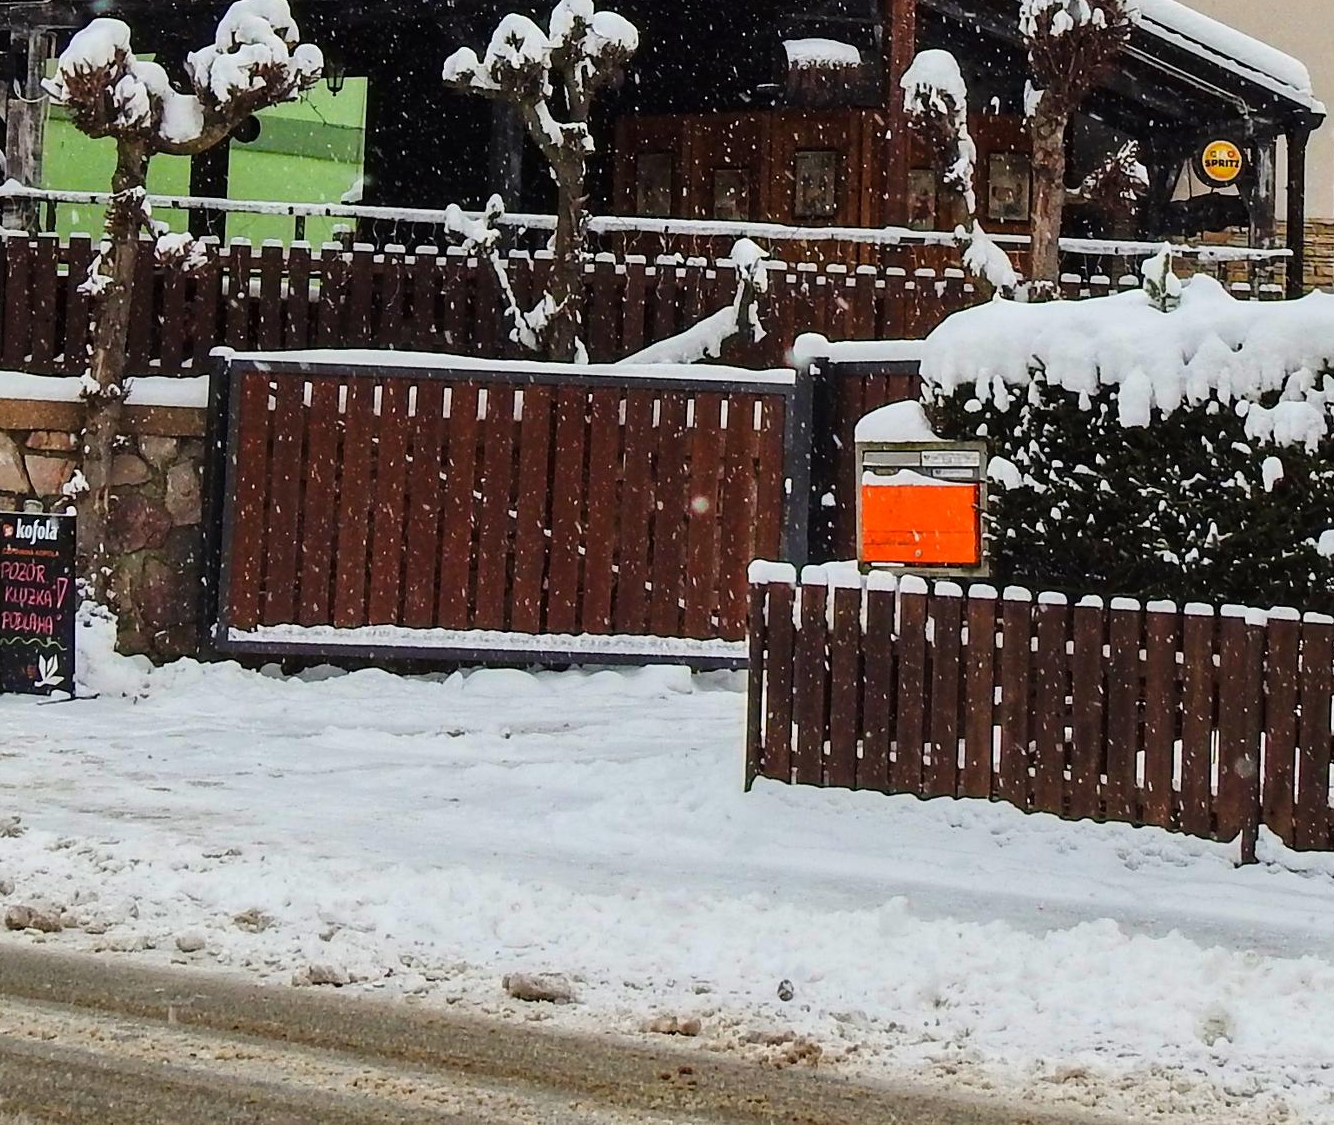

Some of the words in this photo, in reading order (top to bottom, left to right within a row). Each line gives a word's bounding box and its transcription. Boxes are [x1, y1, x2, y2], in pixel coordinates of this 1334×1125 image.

[1205, 159, 1239, 168] SPRITZ
[16, 518, 58, 545] kofola
[0, 561, 46, 584] POZOR
[1, 610, 53, 636] PODLAHA
